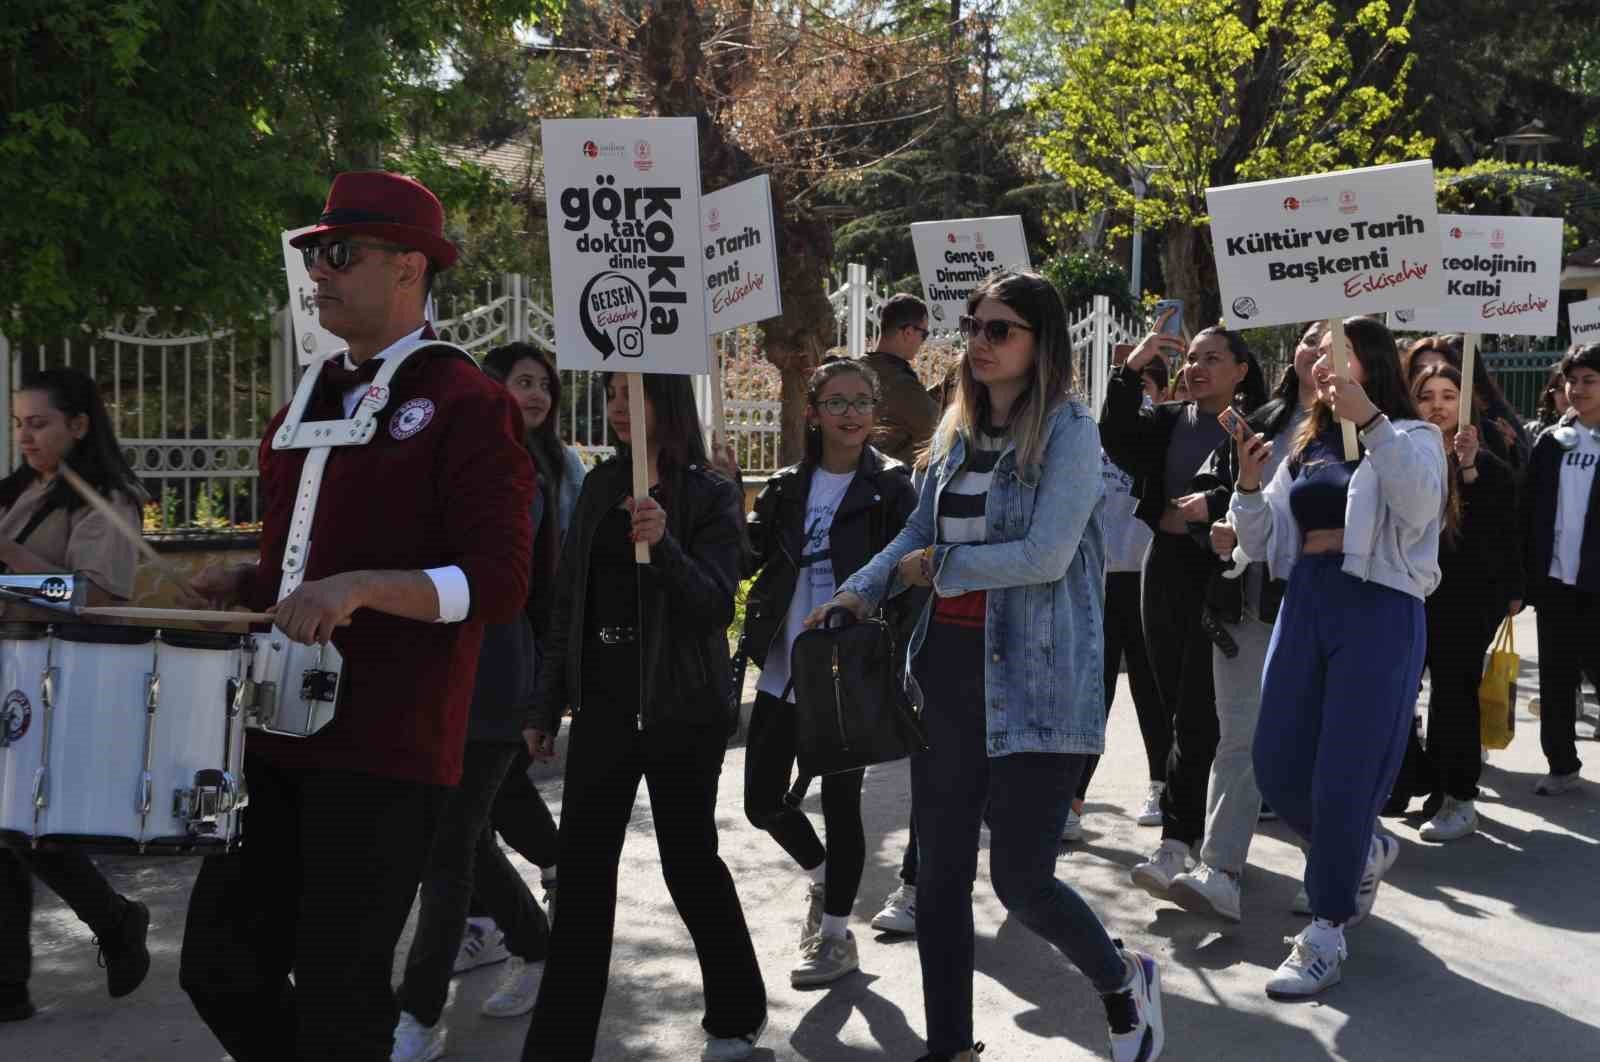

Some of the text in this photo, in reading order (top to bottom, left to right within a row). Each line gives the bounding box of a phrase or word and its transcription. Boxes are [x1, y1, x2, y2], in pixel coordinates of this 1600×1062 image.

[560, 174, 643, 232] gör
[575, 233, 647, 253] dokun
[610, 219, 645, 238] tat
[716, 227, 761, 256] Tarih
[1226, 214, 1425, 257] Kültür ve Tarih
[609, 253, 646, 269] dinle
[644, 187, 687, 335] kokla
[944, 250, 994, 267] Genç ve
[1268, 246, 1390, 284] Başkenti
[706, 260, 740, 289] enti
[1343, 259, 1429, 298] Eskişehir
[1447, 279, 1502, 297] Kalbi
[591, 285, 634, 312] GEZSEN
